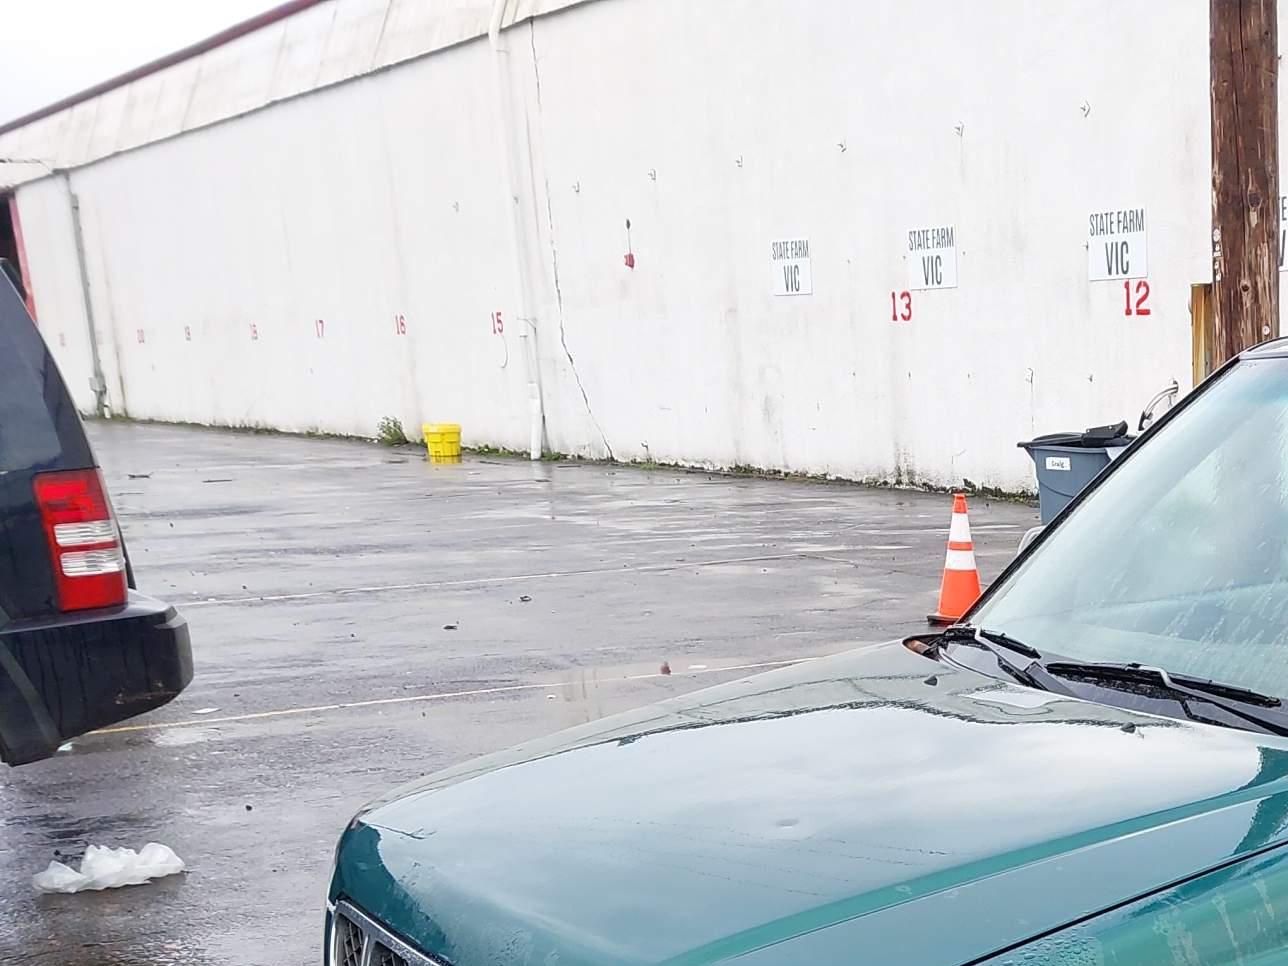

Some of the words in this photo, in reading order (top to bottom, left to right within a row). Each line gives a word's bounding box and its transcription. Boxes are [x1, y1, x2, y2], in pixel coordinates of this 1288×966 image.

[1089, 212, 1115, 236] STATE
[1117, 208, 1144, 233] FARM
[772, 241, 790, 260] STATE
[791, 239, 810, 259] FARM
[908, 230, 930, 251] STATE
[932, 227, 954, 249] FARM
[922, 255, 942, 285] VIC
[1105, 241, 1129, 275] VIC
[783, 265, 800, 292] VIC
[891, 291, 912, 321] 13
[1124, 280, 1151, 316] 12
[315, 319, 325, 338] 17
[394, 315, 406, 335] 16
[490, 311, 504, 335] 15
